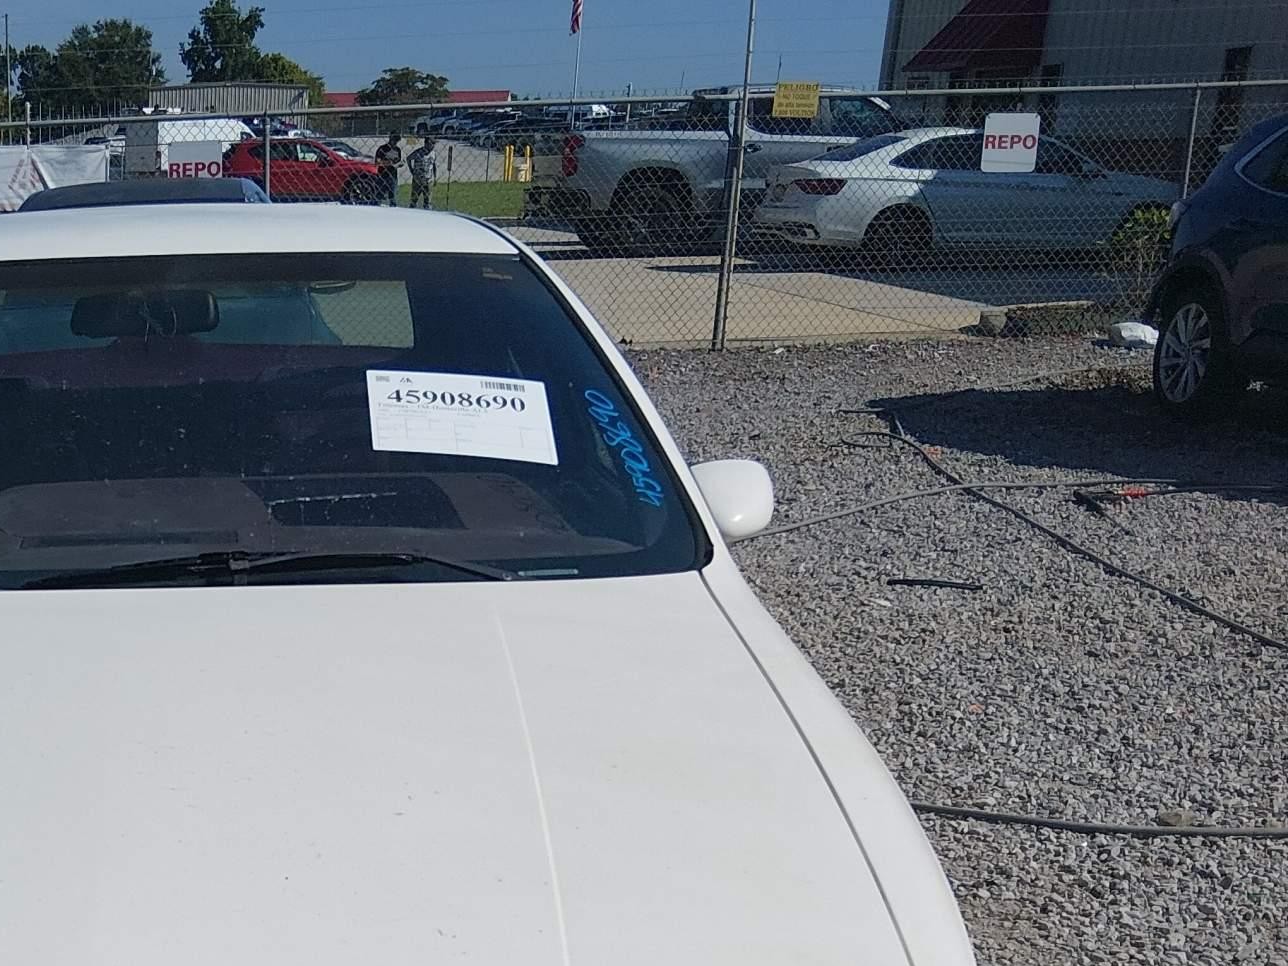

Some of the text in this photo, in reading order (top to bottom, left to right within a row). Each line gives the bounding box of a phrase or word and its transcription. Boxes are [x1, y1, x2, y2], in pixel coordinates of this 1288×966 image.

[984, 134, 1037, 150] REPO
[168, 161, 221, 178] REPO
[387, 389, 526, 413] 45908690
